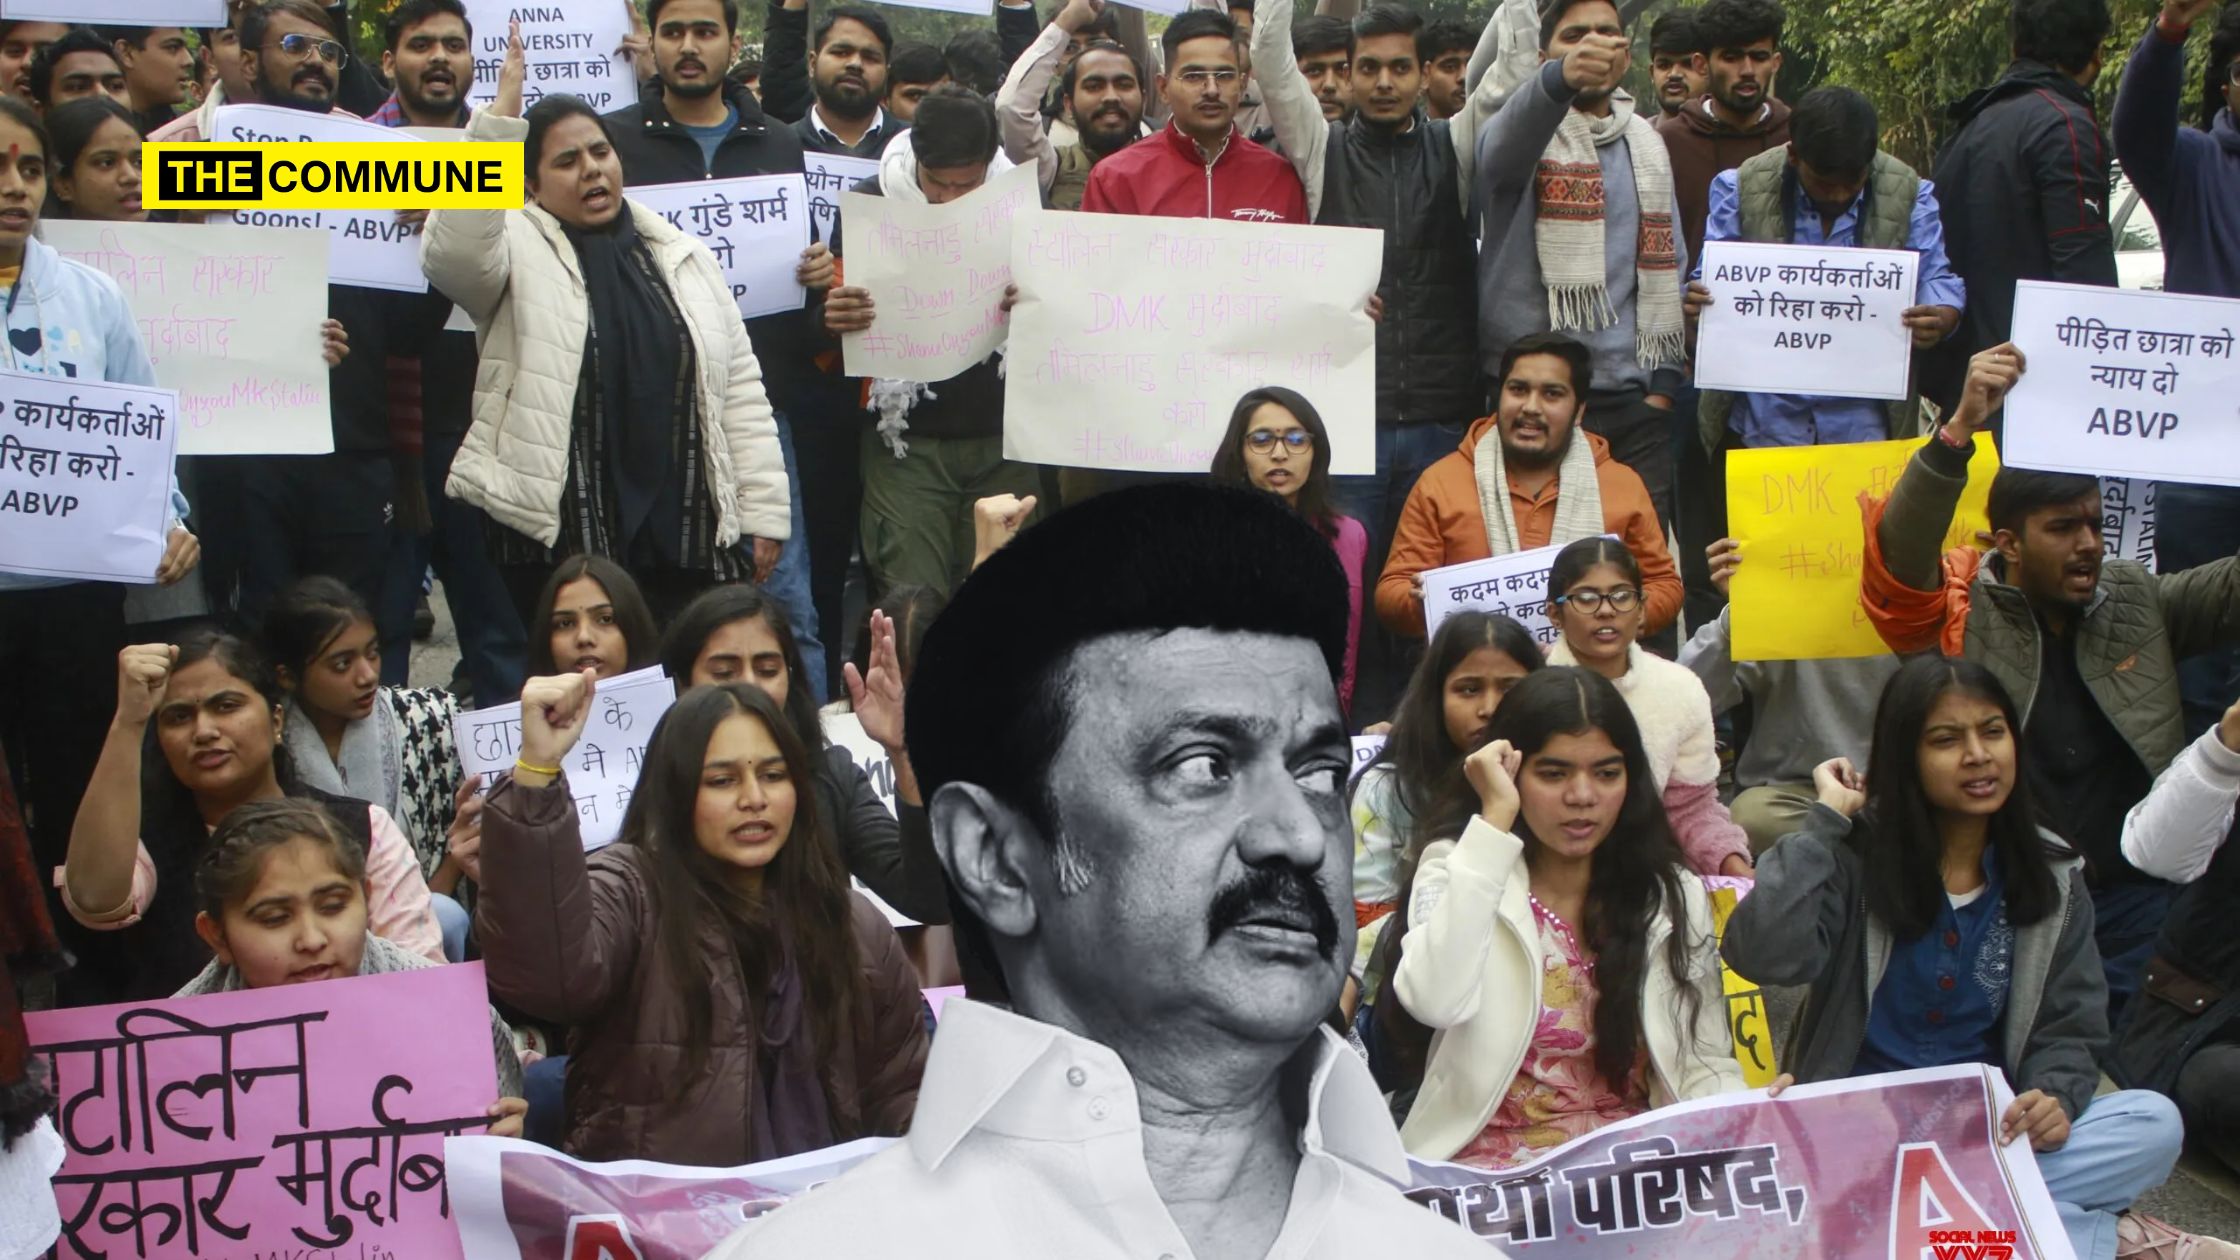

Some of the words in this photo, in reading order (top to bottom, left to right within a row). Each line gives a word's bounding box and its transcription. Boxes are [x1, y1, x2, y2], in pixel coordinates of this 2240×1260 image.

[484, 33, 593, 52] UNVERSITY
[533, 61, 580, 80] छात्रा
[584, 54, 611, 78] को
[739, 187, 788, 223] शर्म
[344, 217, 411, 243] ABVP
[1715, 264, 1771, 283] ABVP
[1777, 259, 1903, 290] कार्यकर्ताओं
[1084, 291, 1170, 334] DMK
[1734, 289, 1764, 317] को
[1770, 291, 1815, 321] रिहा
[1820, 295, 1865, 321] करो
[1774, 331, 1832, 350] ABVP
[2137, 330, 2194, 356] छात्रा
[2200, 328, 2235, 358] को
[2090, 364, 2147, 390] न्याय
[2152, 362, 2179, 395] दो
[14, 396, 165, 440] कार्यकर्ताओं
[2087, 407, 2178, 439] ABVP
[67, 445, 121, 481] करो
[1, 489, 79, 517] ABVP
[1762, 467, 1838, 515] DMK
[1449, 578, 1499, 602] कदम
